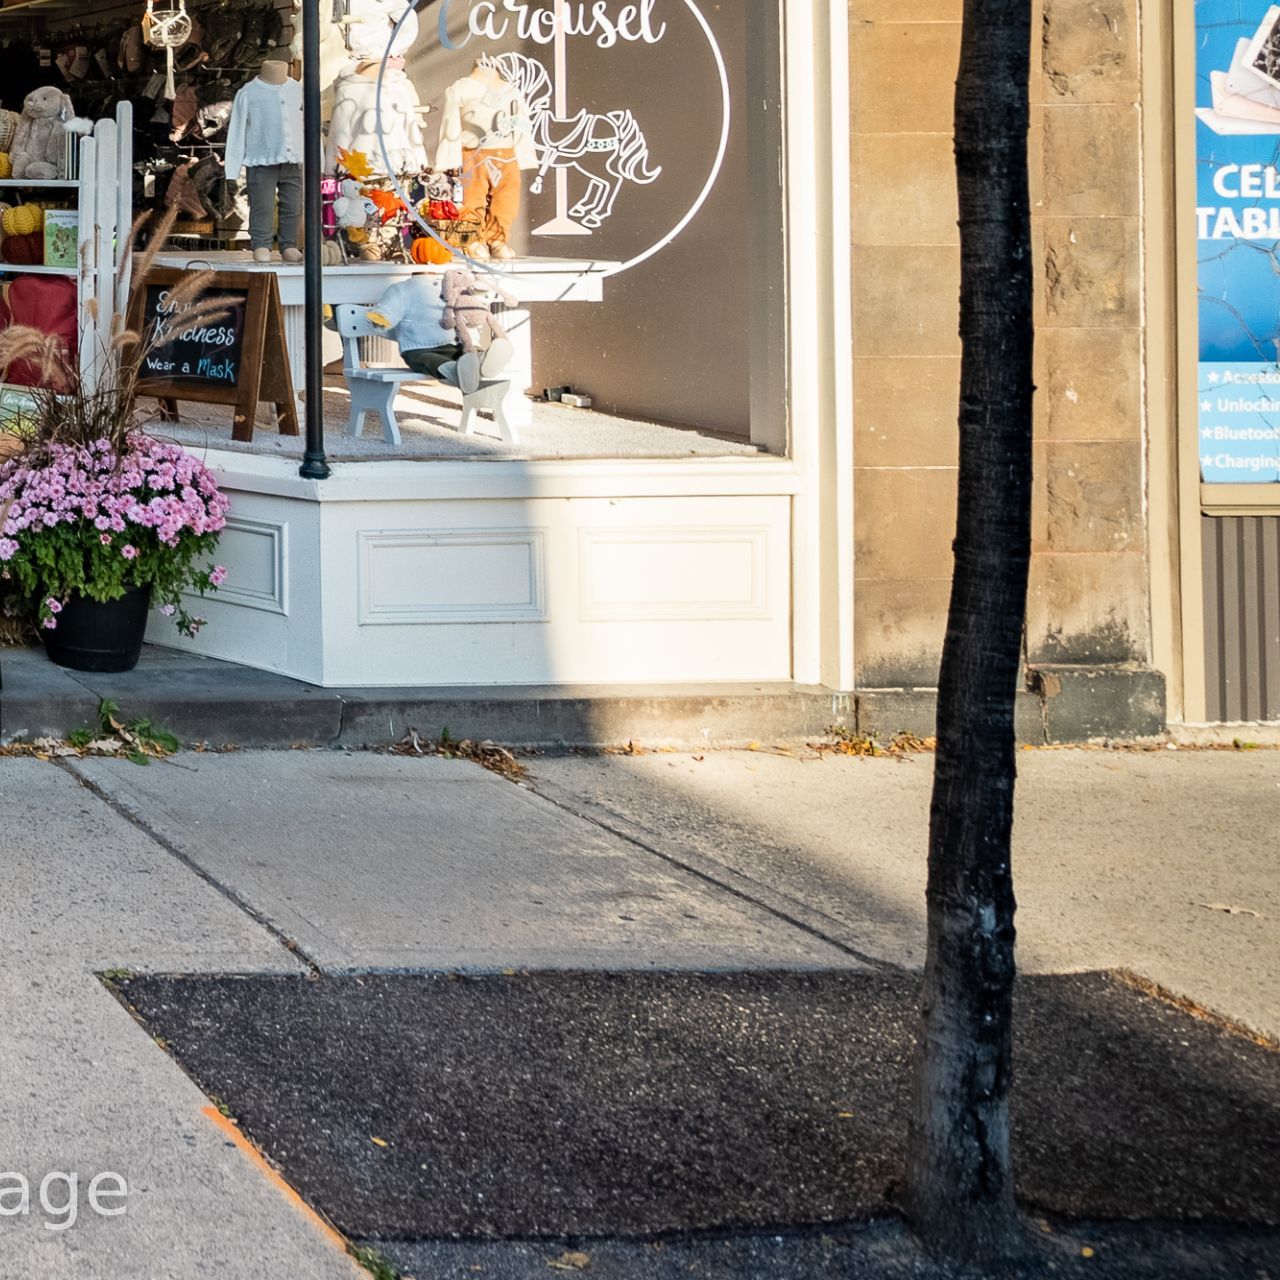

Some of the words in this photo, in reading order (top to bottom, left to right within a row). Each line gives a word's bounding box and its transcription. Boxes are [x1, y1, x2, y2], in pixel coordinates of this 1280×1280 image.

[146, 357, 176, 370] Wear
[181, 362, 190, 373] a
[197, 358, 236, 384] Mask
